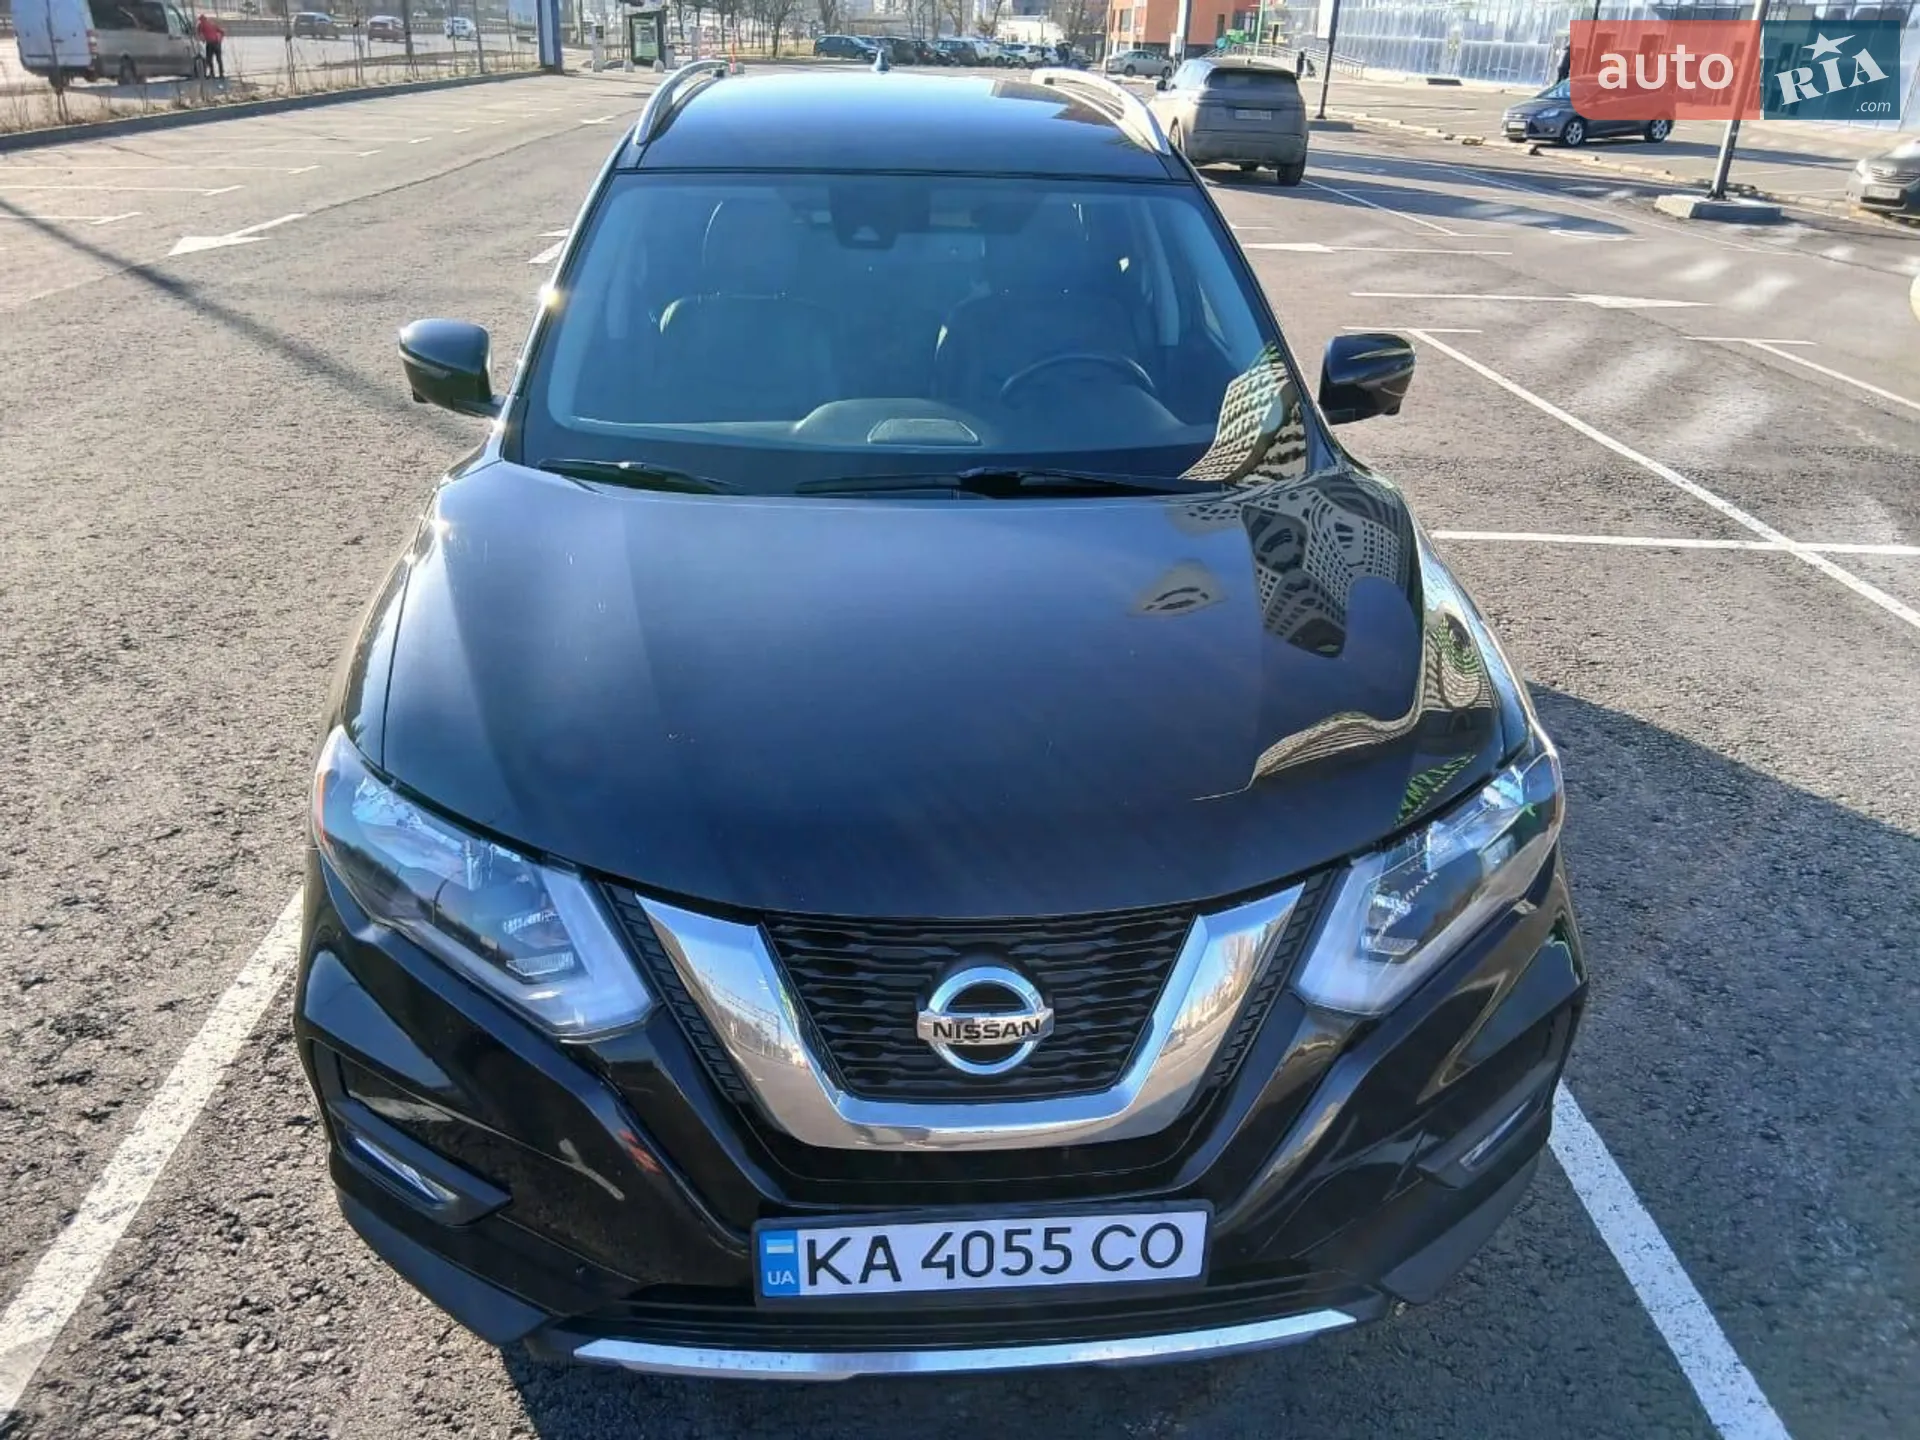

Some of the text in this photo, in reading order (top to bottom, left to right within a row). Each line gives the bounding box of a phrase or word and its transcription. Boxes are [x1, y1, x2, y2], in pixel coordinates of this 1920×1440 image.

[932, 1019, 1040, 1039] NISSAN
[806, 1222, 1184, 1286] KA 4055 CO
[767, 1270, 796, 1286] UA
